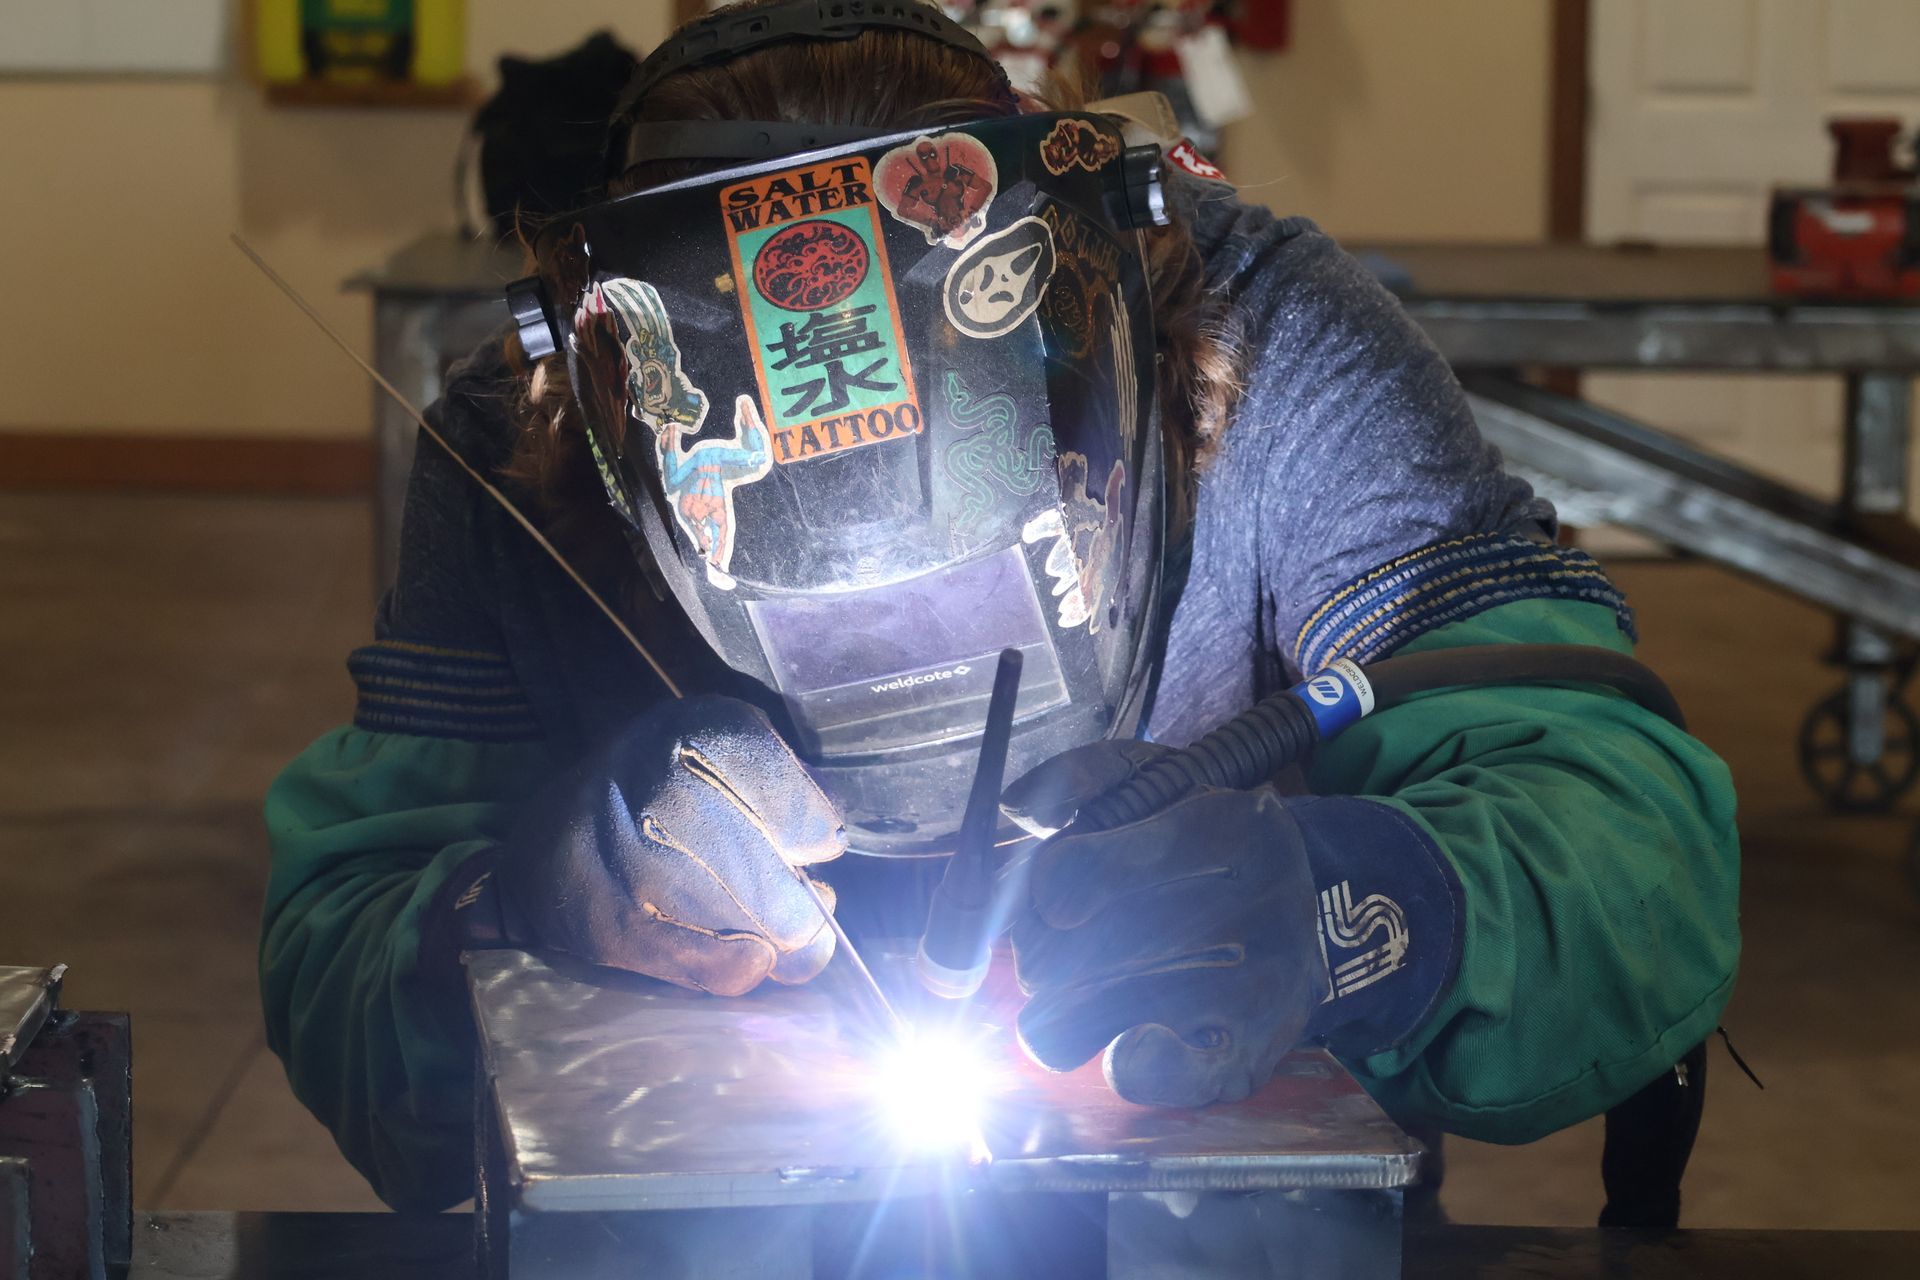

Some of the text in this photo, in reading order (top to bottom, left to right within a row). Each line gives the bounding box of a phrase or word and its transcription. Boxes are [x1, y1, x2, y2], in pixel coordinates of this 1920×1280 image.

[728, 162, 864, 211] SALT
[728, 183, 872, 233] WATER
[766, 304, 898, 418] 塩水
[774, 404, 919, 460] TATTOO
[871, 670, 952, 693] weldcote
